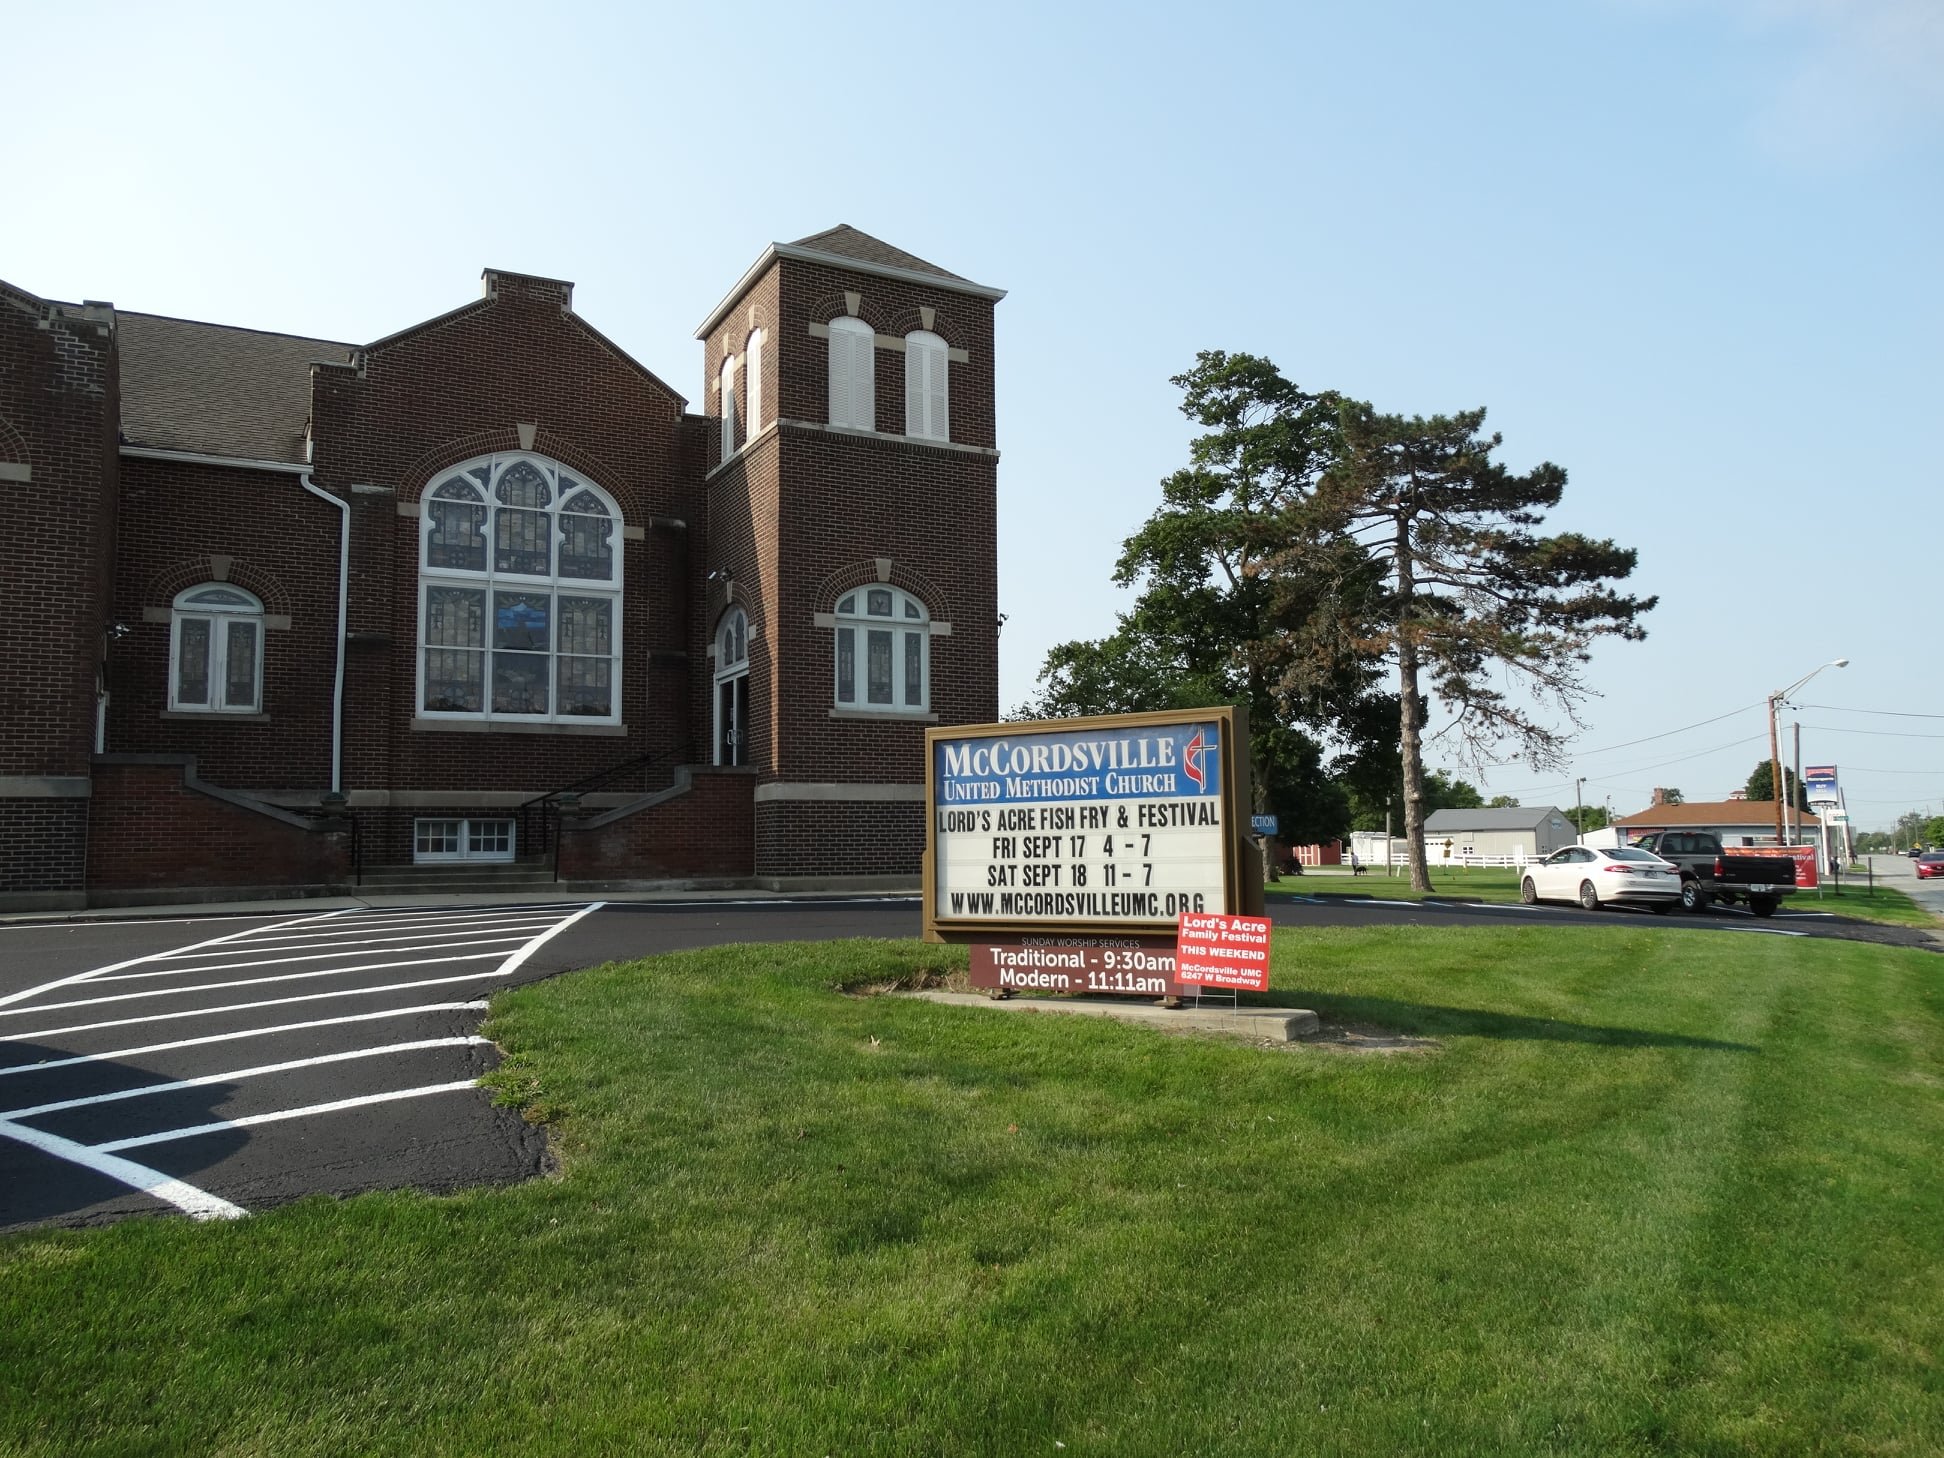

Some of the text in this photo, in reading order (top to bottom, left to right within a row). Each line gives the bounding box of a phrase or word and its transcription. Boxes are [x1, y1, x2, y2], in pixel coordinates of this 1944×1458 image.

[943, 771, 1176, 801] UNITED METHODIST CHURCH
[939, 801, 1220, 833] LORD'S ACRE FISH FRY & FESTIVAL
[993, 837, 1016, 859] FRI
[1023, 835, 1062, 858] SEPT
[1069, 835, 1086, 858] 17
[1103, 834, 1114, 857] 4
[1141, 833, 1151, 857] 7
[987, 864, 1017, 887] SAT
[1023, 864, 1062, 887] SEPT
[1070, 864, 1087, 887] 18
[1103, 863, 1116, 887] 11
[1142, 863, 1152, 887] 7
[1183, 915, 1267, 933] Lord's Acre
[1021, 937, 1141, 949] SUNDAY WORSHIP SERVICES
[1181, 928, 1267, 944] Family Festival
[990, 948, 1086, 969] Traditional
[1104, 950, 1176, 972] 9:30am
[1180, 945, 1266, 960] THIS WEEKEND
[999, 967, 1070, 989] Modern
[1088, 970, 1166, 993] 11:11am
[1180, 962, 1263, 978] McCordsville UMC
[1180, 971, 1262, 988] 6247 W Broadway
